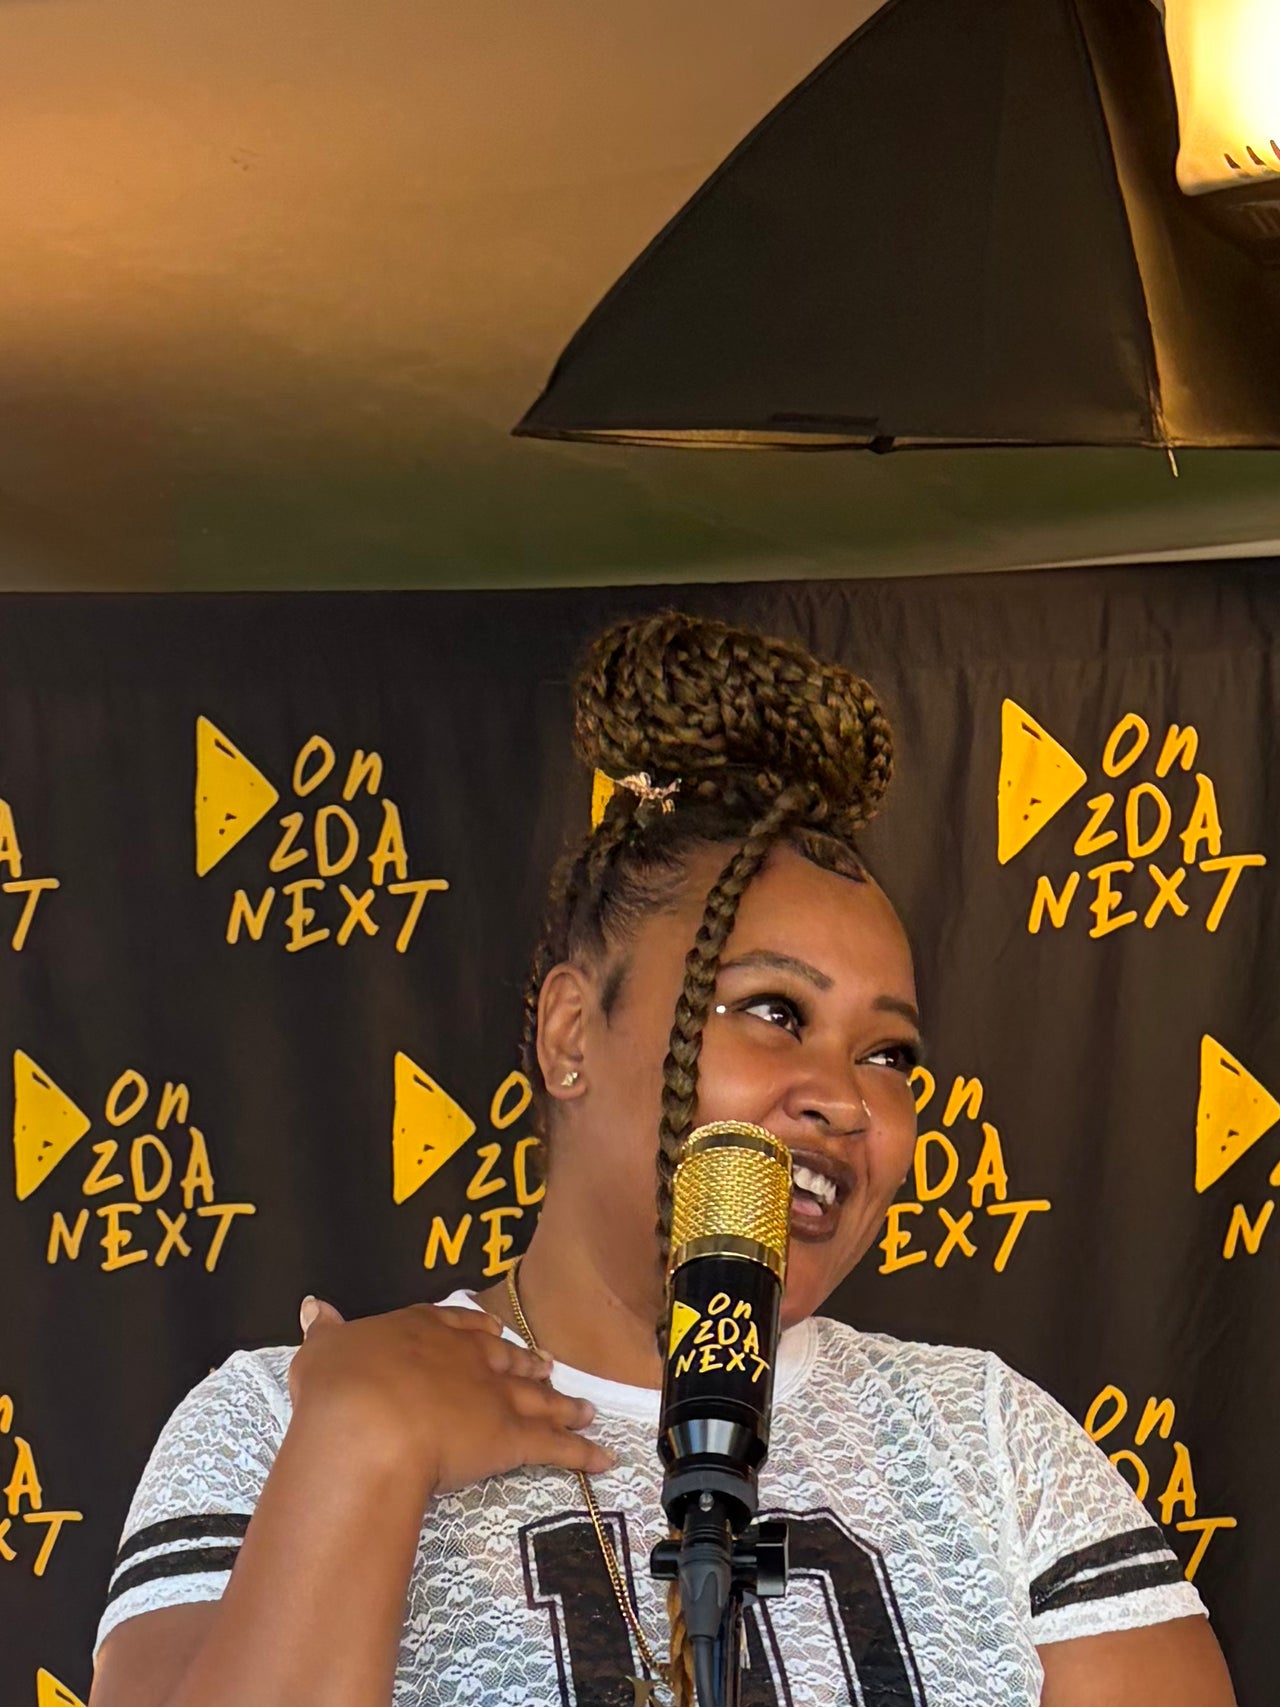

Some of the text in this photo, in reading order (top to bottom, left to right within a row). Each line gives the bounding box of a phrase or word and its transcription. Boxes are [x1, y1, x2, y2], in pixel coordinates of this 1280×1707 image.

[293, 735, 382, 801] On
[1101, 712, 1199, 778] On
[226, 879, 449, 953] NEXT
[1027, 853, 1267, 933] NEXT
[105, 1069, 189, 1130] On
[47, 1202, 256, 1272] NEXT
[423, 1207, 526, 1279] NE
[878, 1196, 1051, 1275] EXT
[708, 1292, 752, 1320] On
[674, 1344, 771, 1383] NEXT
